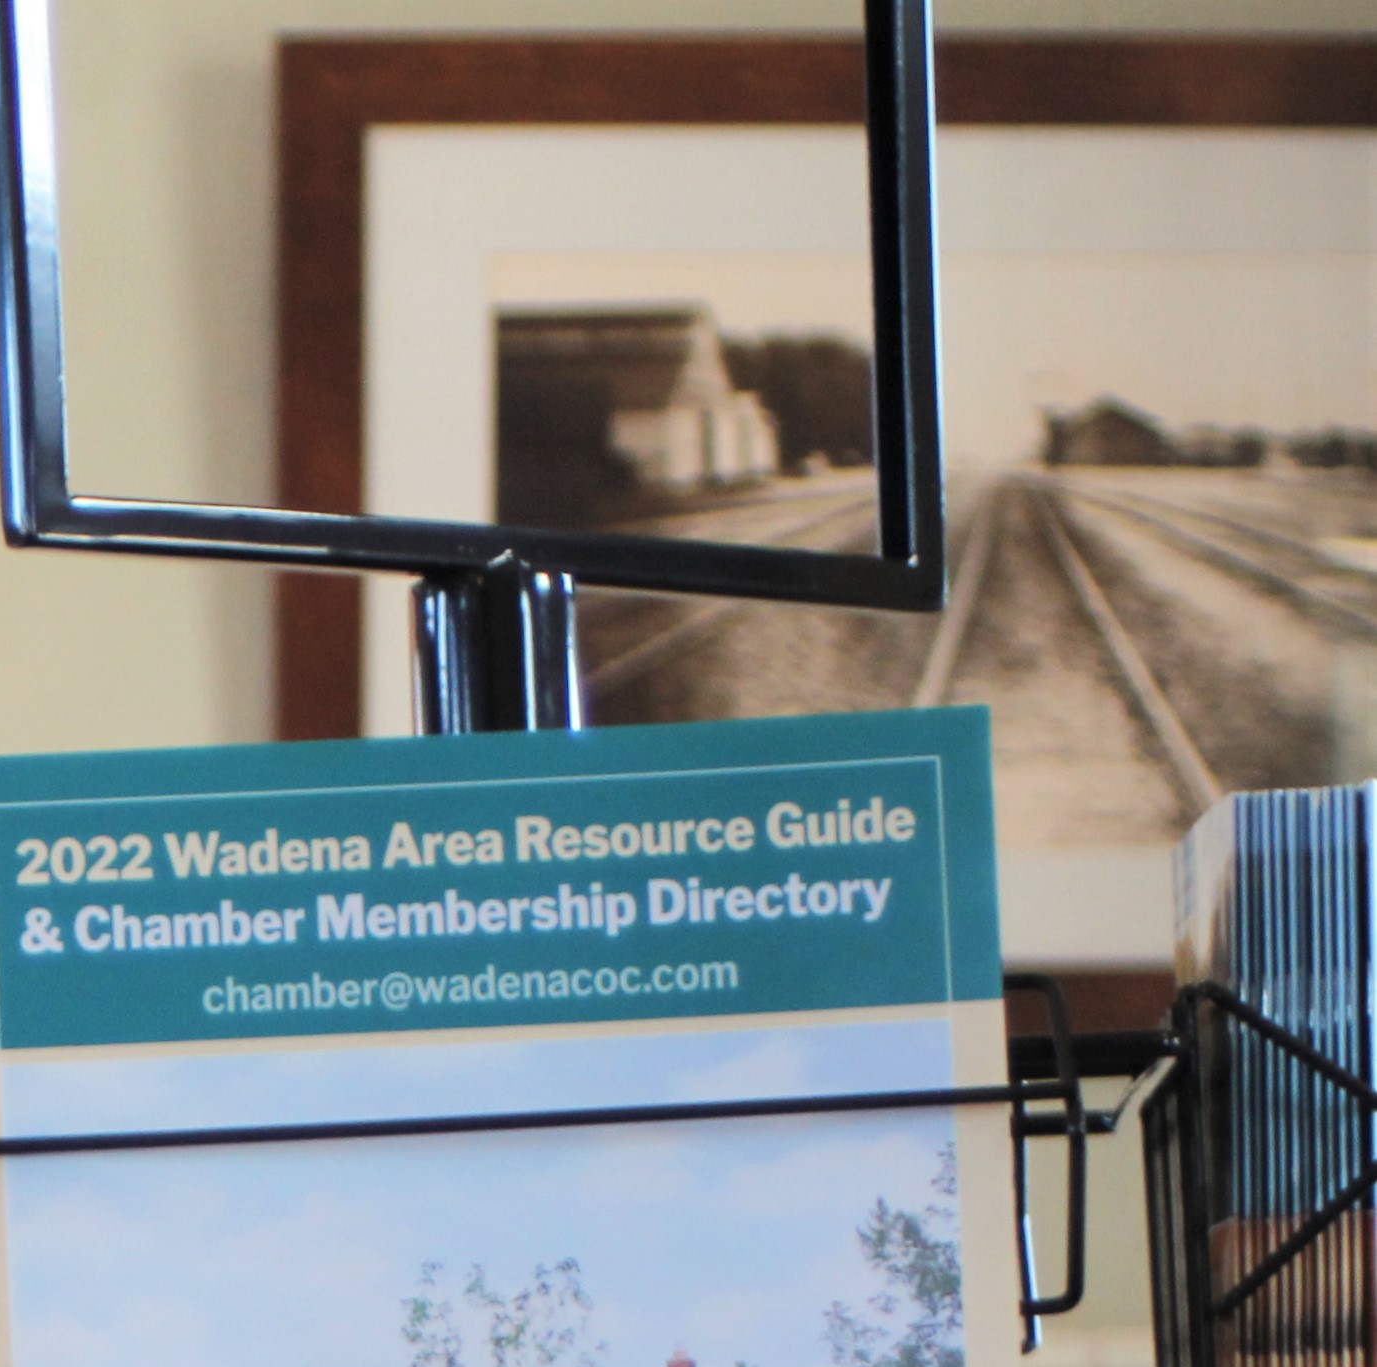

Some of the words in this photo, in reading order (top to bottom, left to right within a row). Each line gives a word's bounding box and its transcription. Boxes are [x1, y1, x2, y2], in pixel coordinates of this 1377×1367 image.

[15, 834, 153, 886] 2022
[164, 828, 371, 879] Wadena
[382, 820, 504, 871] Area
[515, 811, 756, 864] Resource
[766, 797, 917, 851] Guide
[18, 910, 64, 954] &
[74, 894, 306, 951] Chamber
[316, 884, 637, 945] Membership
[648, 872, 893, 928] Directory
[201, 953, 740, 1016] chamber@wadenacoc.com
